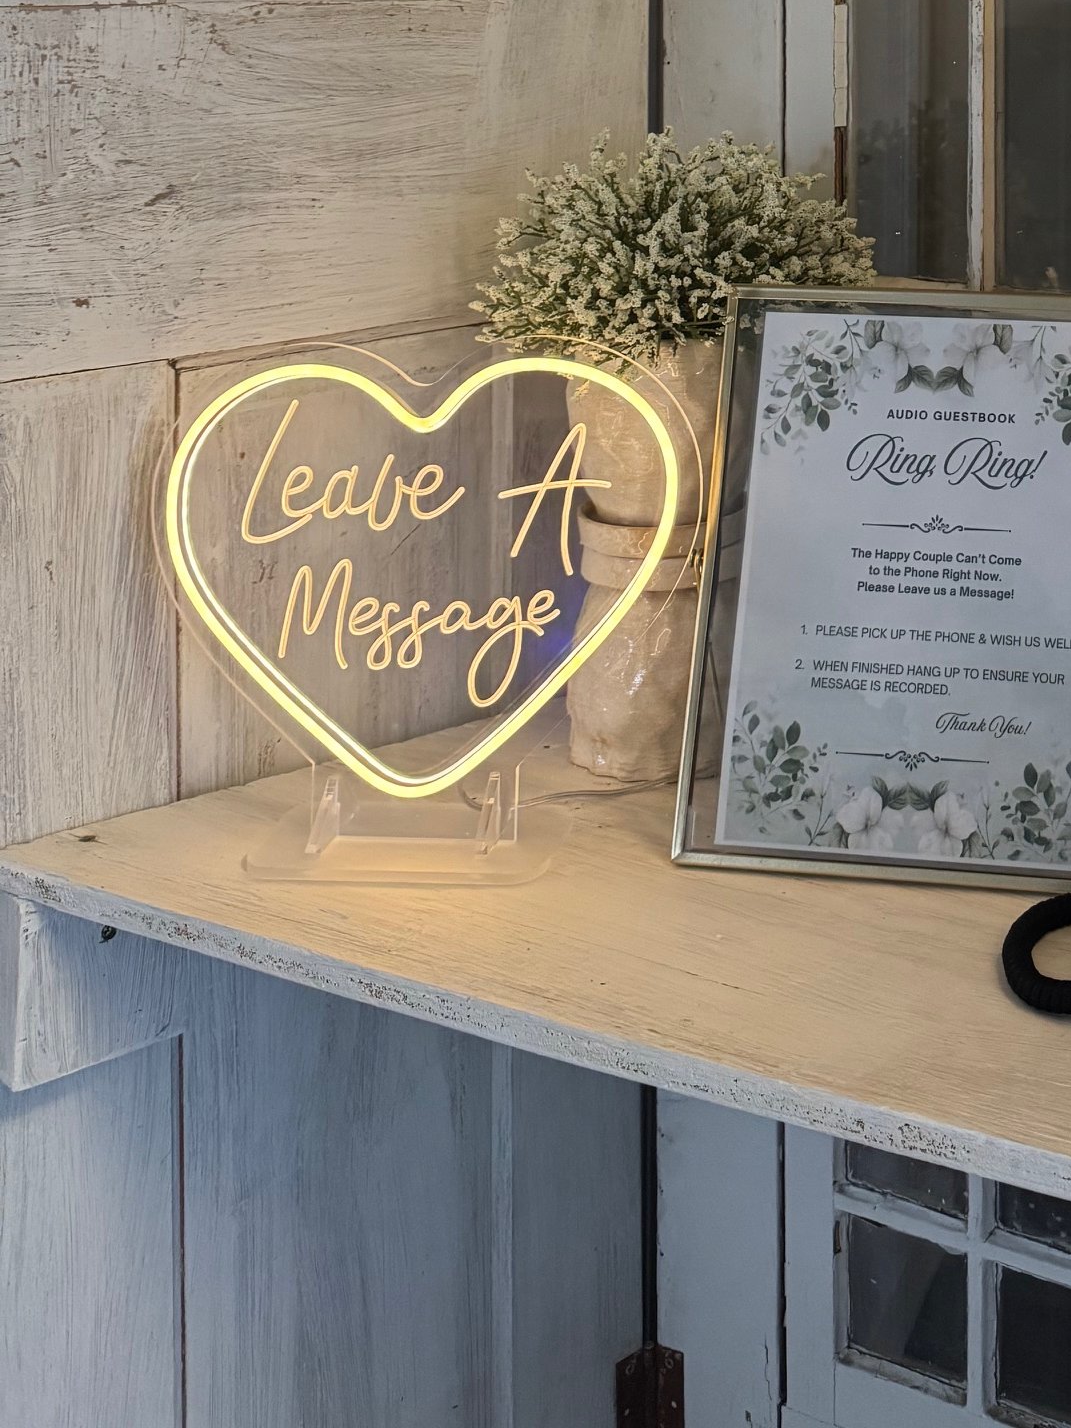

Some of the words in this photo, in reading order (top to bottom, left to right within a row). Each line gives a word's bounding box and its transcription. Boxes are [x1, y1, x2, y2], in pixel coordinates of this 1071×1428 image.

[886, 409, 928, 420] AUDIO
[933, 410, 1016, 424] GUESTBOOK
[846, 433, 937, 486] Ring,
[944, 437, 1048, 490] Ring!
[242, 399, 465, 544] Leave
[498, 423, 611, 575] A
[851, 548, 872, 558] The
[874, 549, 910, 562] Happy
[913, 550, 953, 564] Couple
[988, 554, 1022, 566] Come
[868, 565, 880, 576] to
[883, 566, 901, 576] the
[904, 567, 939, 578] Phone
[942, 568, 971, 582] Right
[974, 570, 1002, 582] Now.
[857, 581, 895, 593] Please
[898, 583, 930, 594] Leave
[934, 587, 946, 596] us
[950, 588, 956, 596] a
[959, 586, 1014, 601] Message!
[278, 558, 560, 708] Message
[800, 624, 808, 635] 1.
[816, 624, 858, 637] PLEASE
[861, 627, 888, 638] PICK
[890, 628, 906, 640] UP
[909, 630, 932, 642] THE
[934, 631, 975, 644] PHONE
[978, 633, 986, 644] &
[990, 634, 1021, 646] WISH
[1024, 636, 1040, 647] US
[794, 658, 804, 670] 2.
[813, 660, 848, 672] WHEN
[852, 661, 904, 675] FINISHED
[907, 664, 940, 678] HANG
[944, 667, 960, 678] UP
[963, 668, 979, 680] TO
[982, 669, 1029, 682] ENSURE
[1032, 672, 1065, 685] YOUR
[810, 676, 868, 690] MESSAGE
[870, 680, 881, 692] IS
[884, 680, 950, 696] RECORDED.
[936, 712, 986, 734] Thank
[988, 715, 1032, 738] You!
